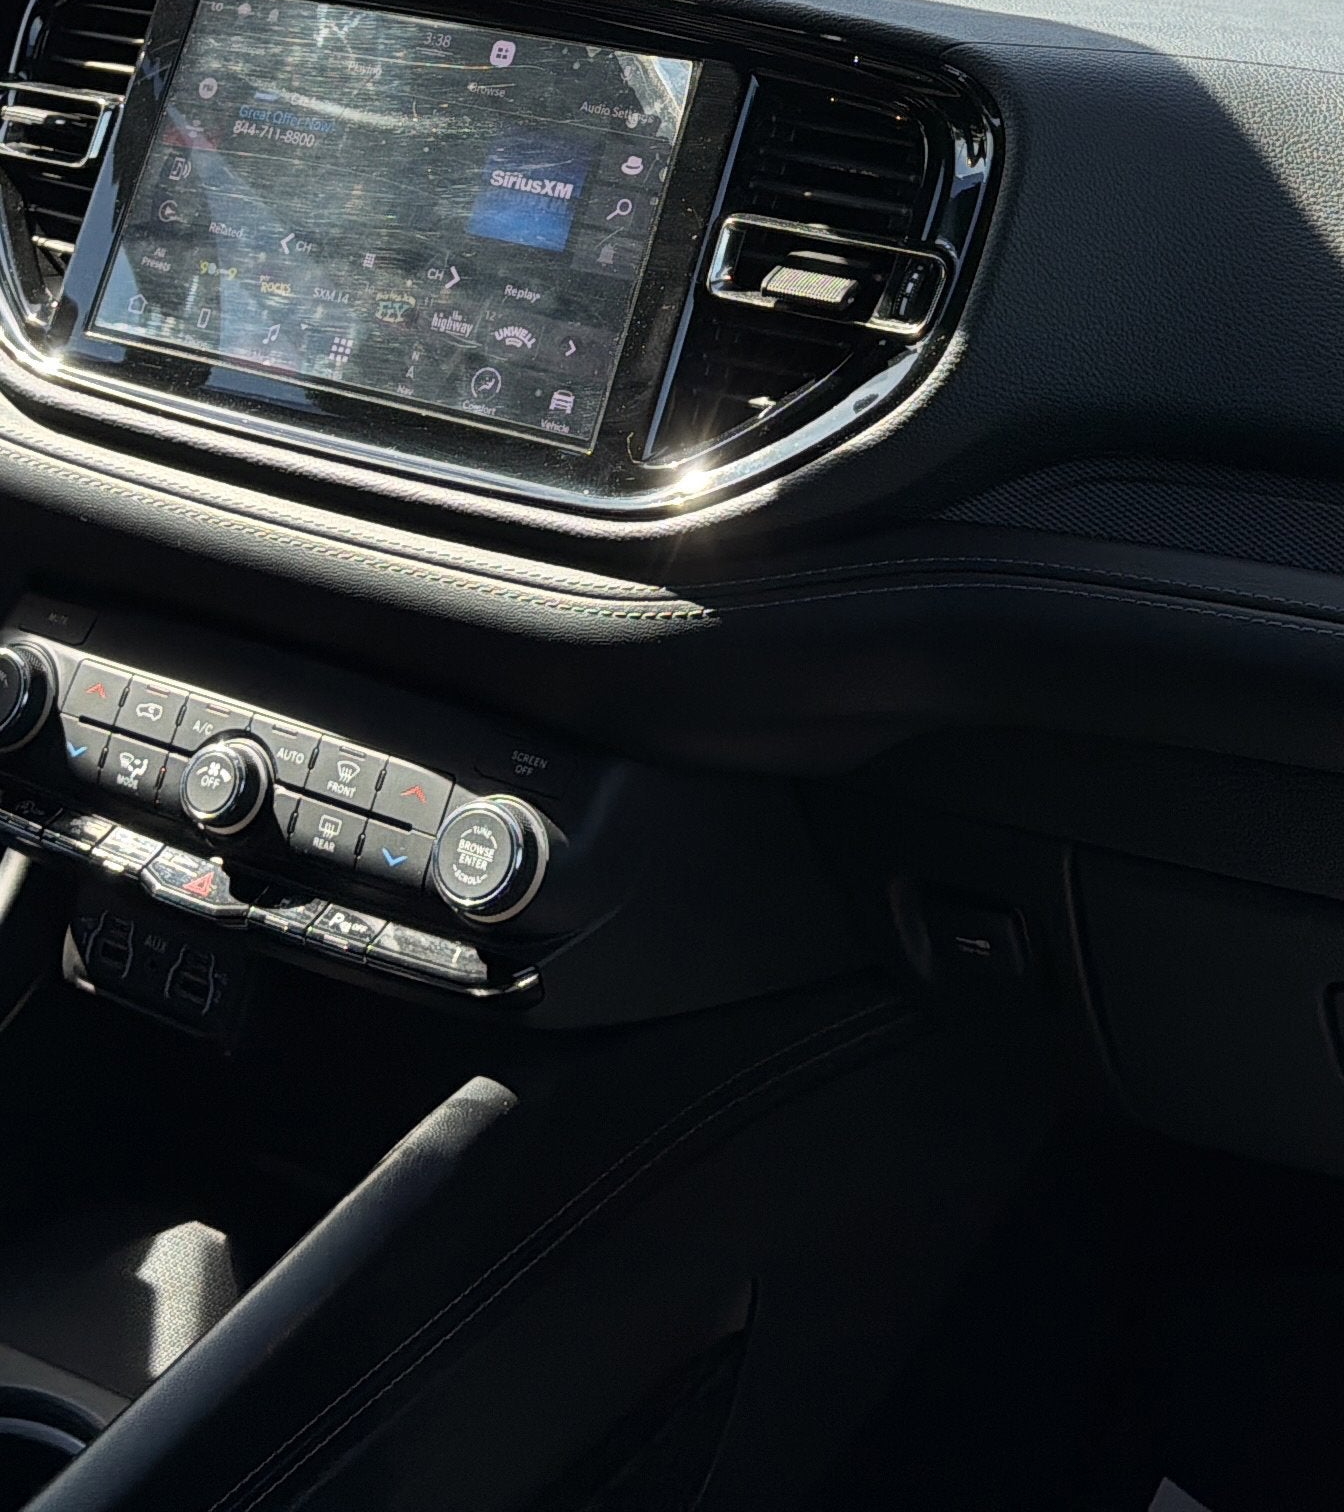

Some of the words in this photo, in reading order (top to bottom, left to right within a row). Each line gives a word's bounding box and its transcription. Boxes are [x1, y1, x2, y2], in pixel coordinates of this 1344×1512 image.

[423, 31, 452, 48] 3:38
[470, 81, 506, 98] Browse
[239, 103, 272, 121] Great
[272, 110, 303, 128] Offer
[579, 100, 611, 116] Audio
[611, 106, 654, 125] Settings
[232, 119, 316, 148] 844-711-8800
[490, 169, 574, 201] SiriusXM
[209, 221, 244, 239] Related
[154, 247, 167, 259] All
[295, 240, 313, 253] CH
[427, 268, 444, 281] CH
[504, 284, 541, 304] Replay
[431, 312, 474, 337] highway
[494, 325, 537, 350] UNWELL
[462, 399, 497, 417] Comfort
[540, 418, 571, 434] Vehicle
[192, 719, 214, 735] A/C
[276, 747, 305, 764] AUTO
[511, 749, 550, 770] SCREEN
[514, 764, 535, 777] OFF
[200, 775, 221, 789] OFF
[326, 779, 357, 799] FRONT
[312, 837, 337, 854] REAR
[458, 838, 496, 857] BROWSE
[458, 853, 489, 872] ENTER
[454, 868, 483, 886] SCROLL
